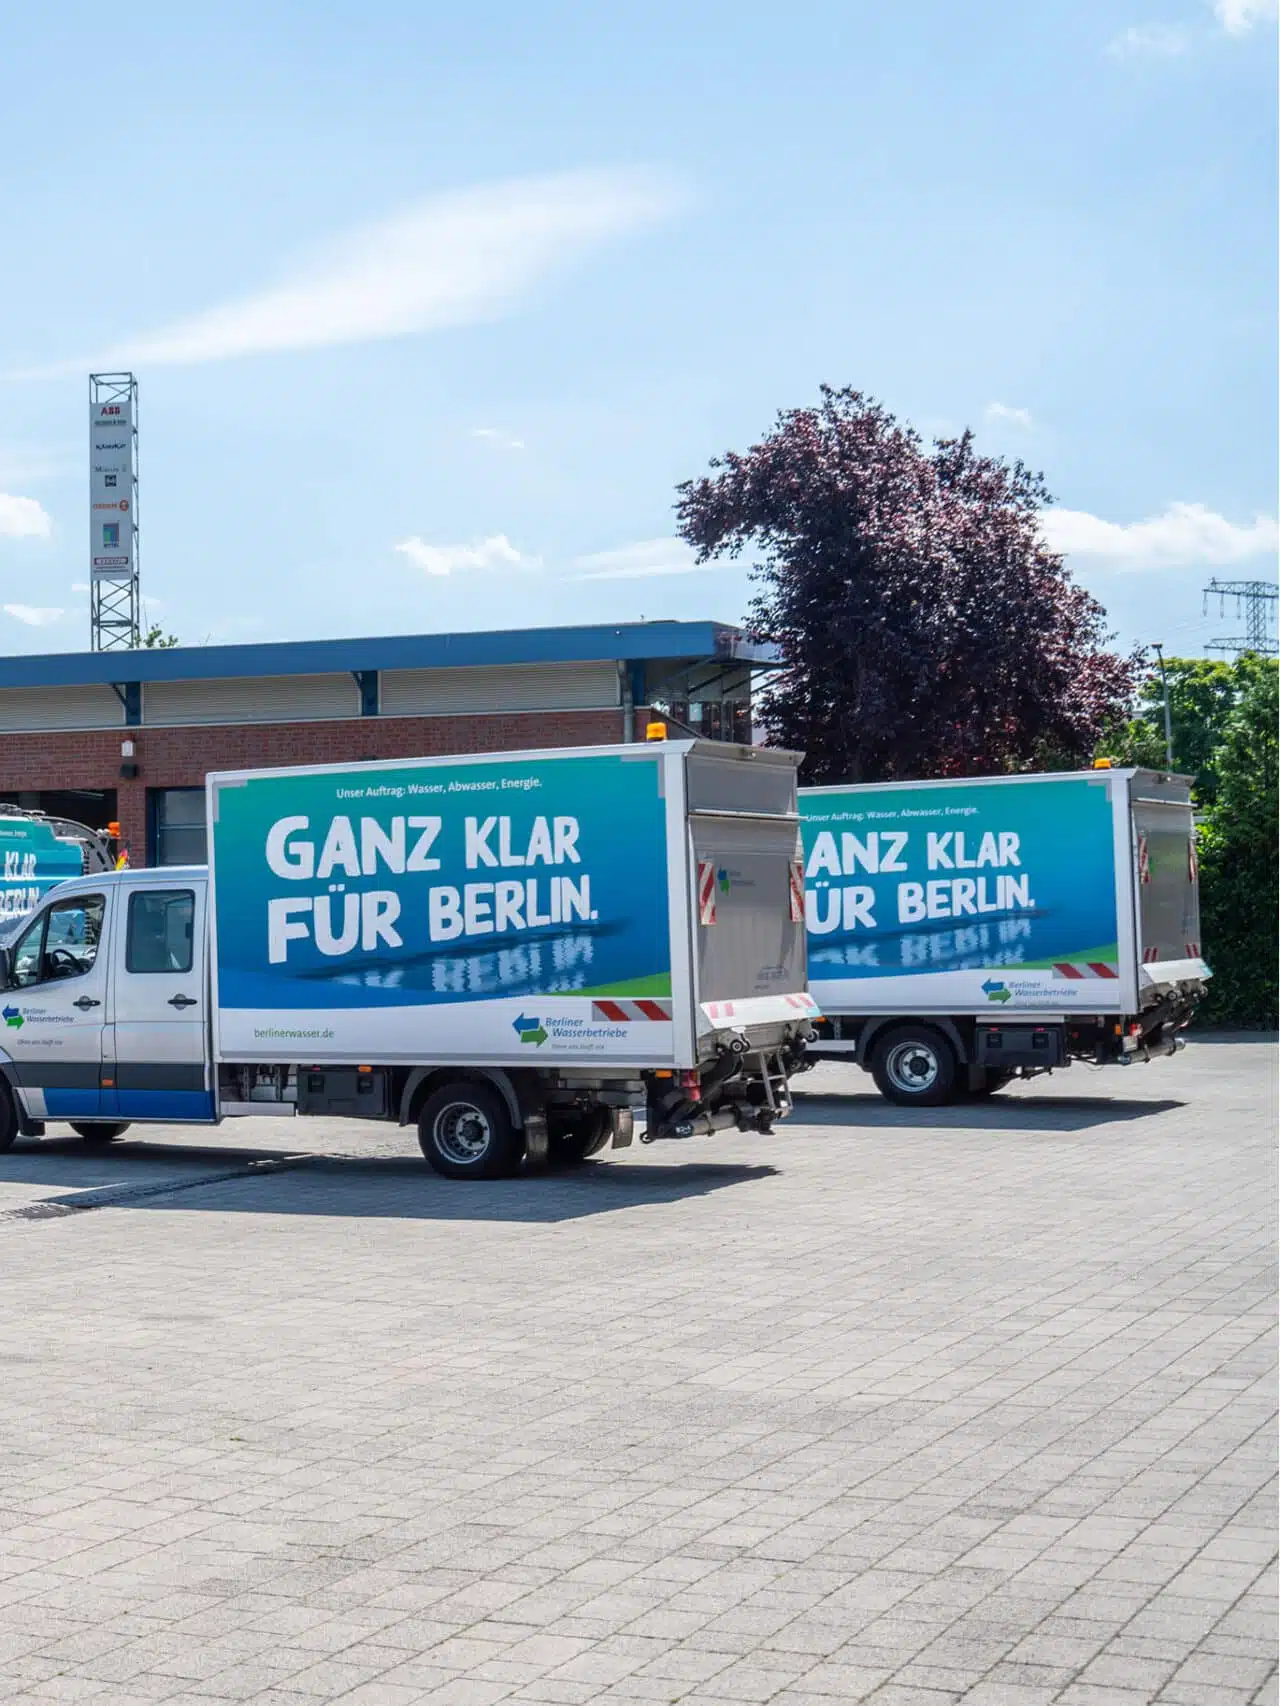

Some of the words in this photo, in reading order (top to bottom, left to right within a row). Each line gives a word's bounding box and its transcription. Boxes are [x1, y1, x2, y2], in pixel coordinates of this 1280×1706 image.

[101, 406, 120, 416] ABB
[336, 788, 364, 799] Unser
[366, 785, 406, 798] Auftrag:
[408, 783, 446, 795] Wasser,
[448, 780, 499, 793] Abwasser,
[501, 777, 542, 791] Energie.
[831, 812, 864, 823] Auftrag:
[866, 810, 899, 820] Wasser,
[901, 808, 943, 818] Abwasser,
[265, 815, 442, 880] GANZ
[464, 816, 581, 869] KLAR
[805, 831, 908, 878] ANZ
[926, 831, 1021, 870] KLAR
[4, 851, 37, 882] KLAR
[805, 881, 877, 935] ÜR
[897, 874, 1036, 924] BERLIN.
[268, 884, 403, 964] FÜR
[429, 874, 599, 941] BERLIN.
[1008, 981, 1041, 989] Berliner
[545, 1017, 584, 1027] Berliner
[253, 1027, 335, 1039] berlinerwasser.de
[552, 1027, 628, 1038] Wasserbetriebe
